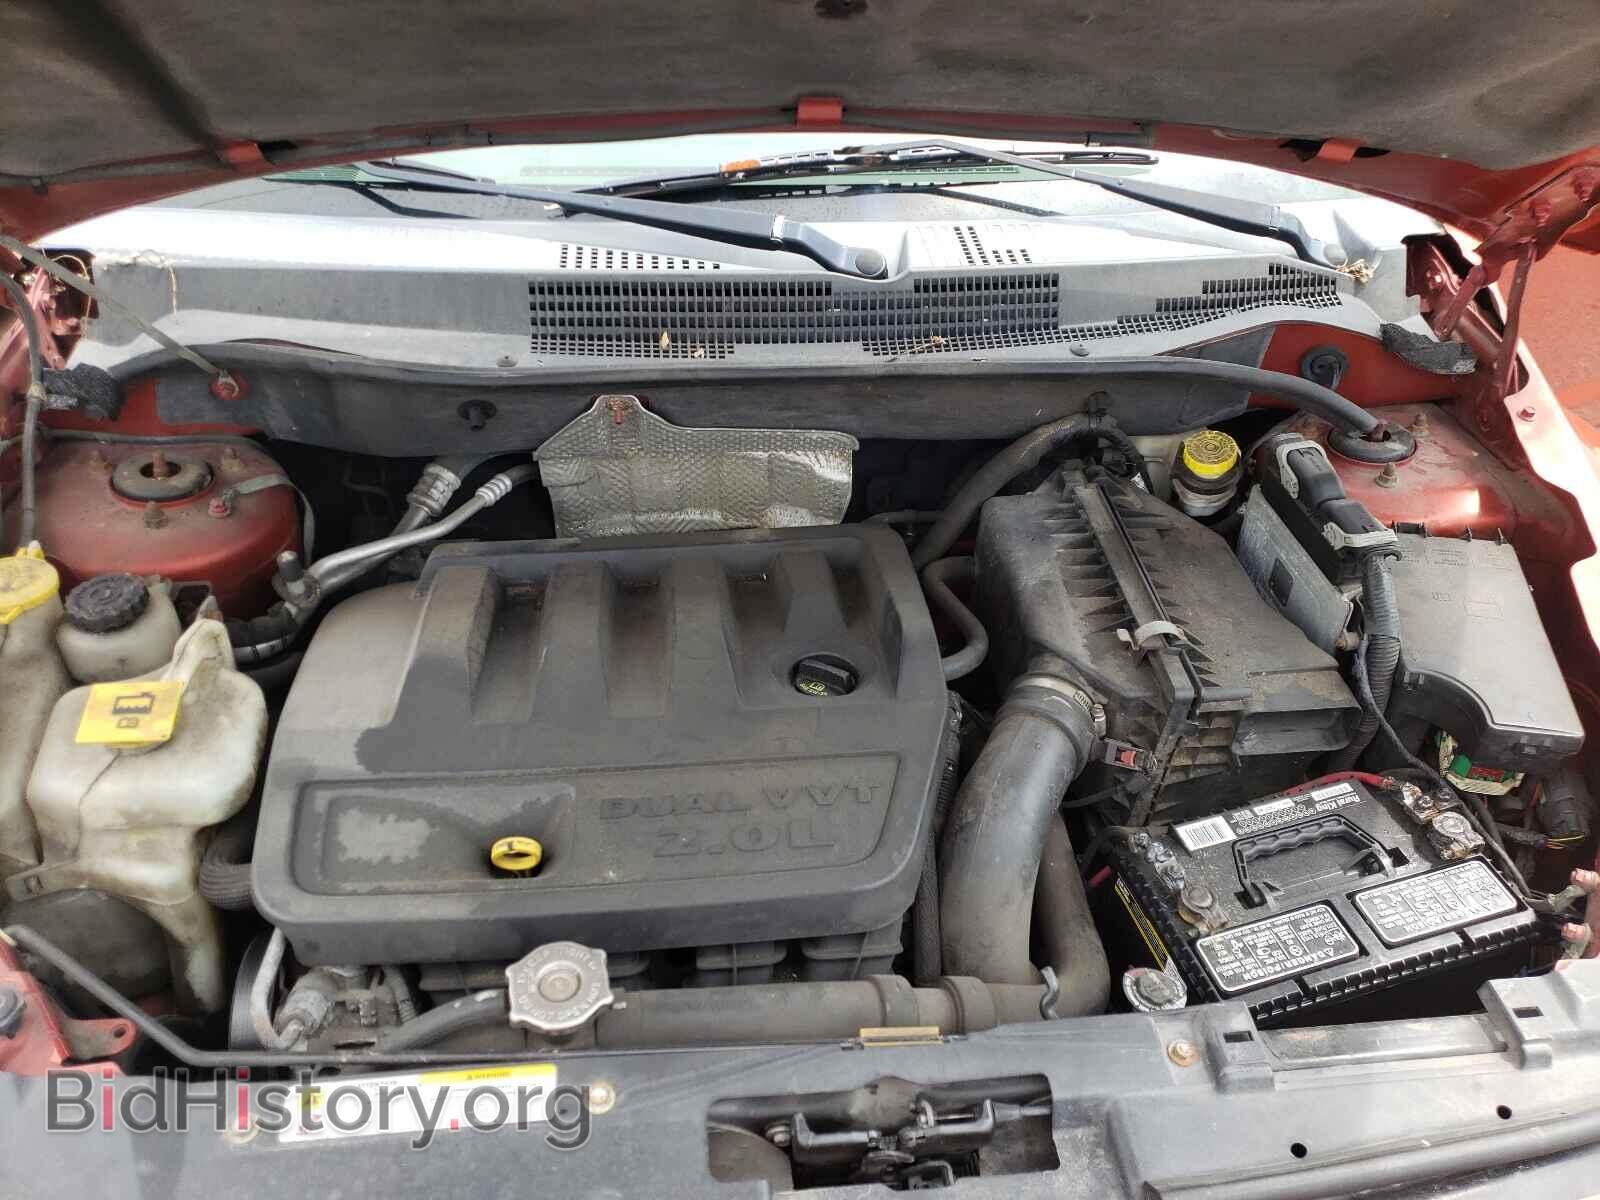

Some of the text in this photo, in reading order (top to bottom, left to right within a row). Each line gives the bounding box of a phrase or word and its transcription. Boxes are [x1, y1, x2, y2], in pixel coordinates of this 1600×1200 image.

[599, 784, 881, 820] DUAL VVT
[1315, 798, 1338, 812] King
[1337, 793, 1361, 809] Rural
[651, 819, 836, 858] 2.0L
